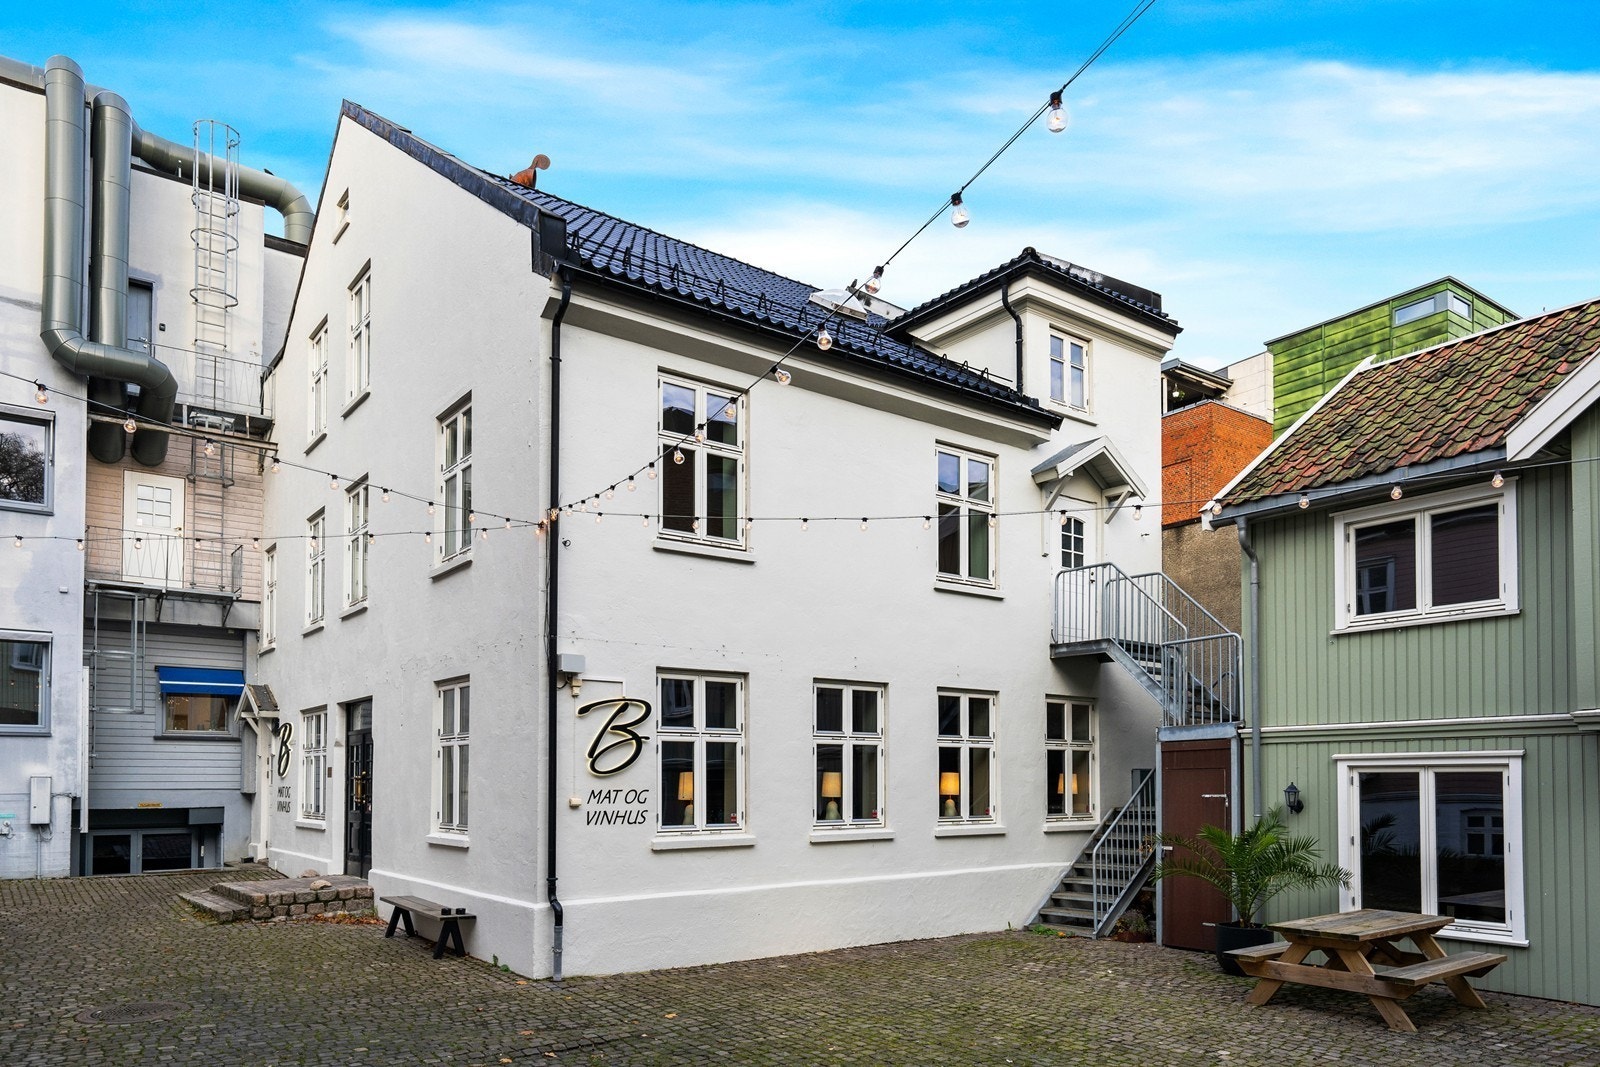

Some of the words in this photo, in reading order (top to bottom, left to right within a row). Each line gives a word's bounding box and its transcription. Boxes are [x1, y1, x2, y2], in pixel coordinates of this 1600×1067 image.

[577, 698, 652, 775] B
[277, 722, 292, 777] B
[277, 786, 285, 798] MAT
[285, 786, 291, 799] OG
[587, 789, 622, 805] MAT
[624, 789, 649, 805] OG
[277, 800, 291, 813] VINHUS
[586, 810, 648, 826] VINHUS
